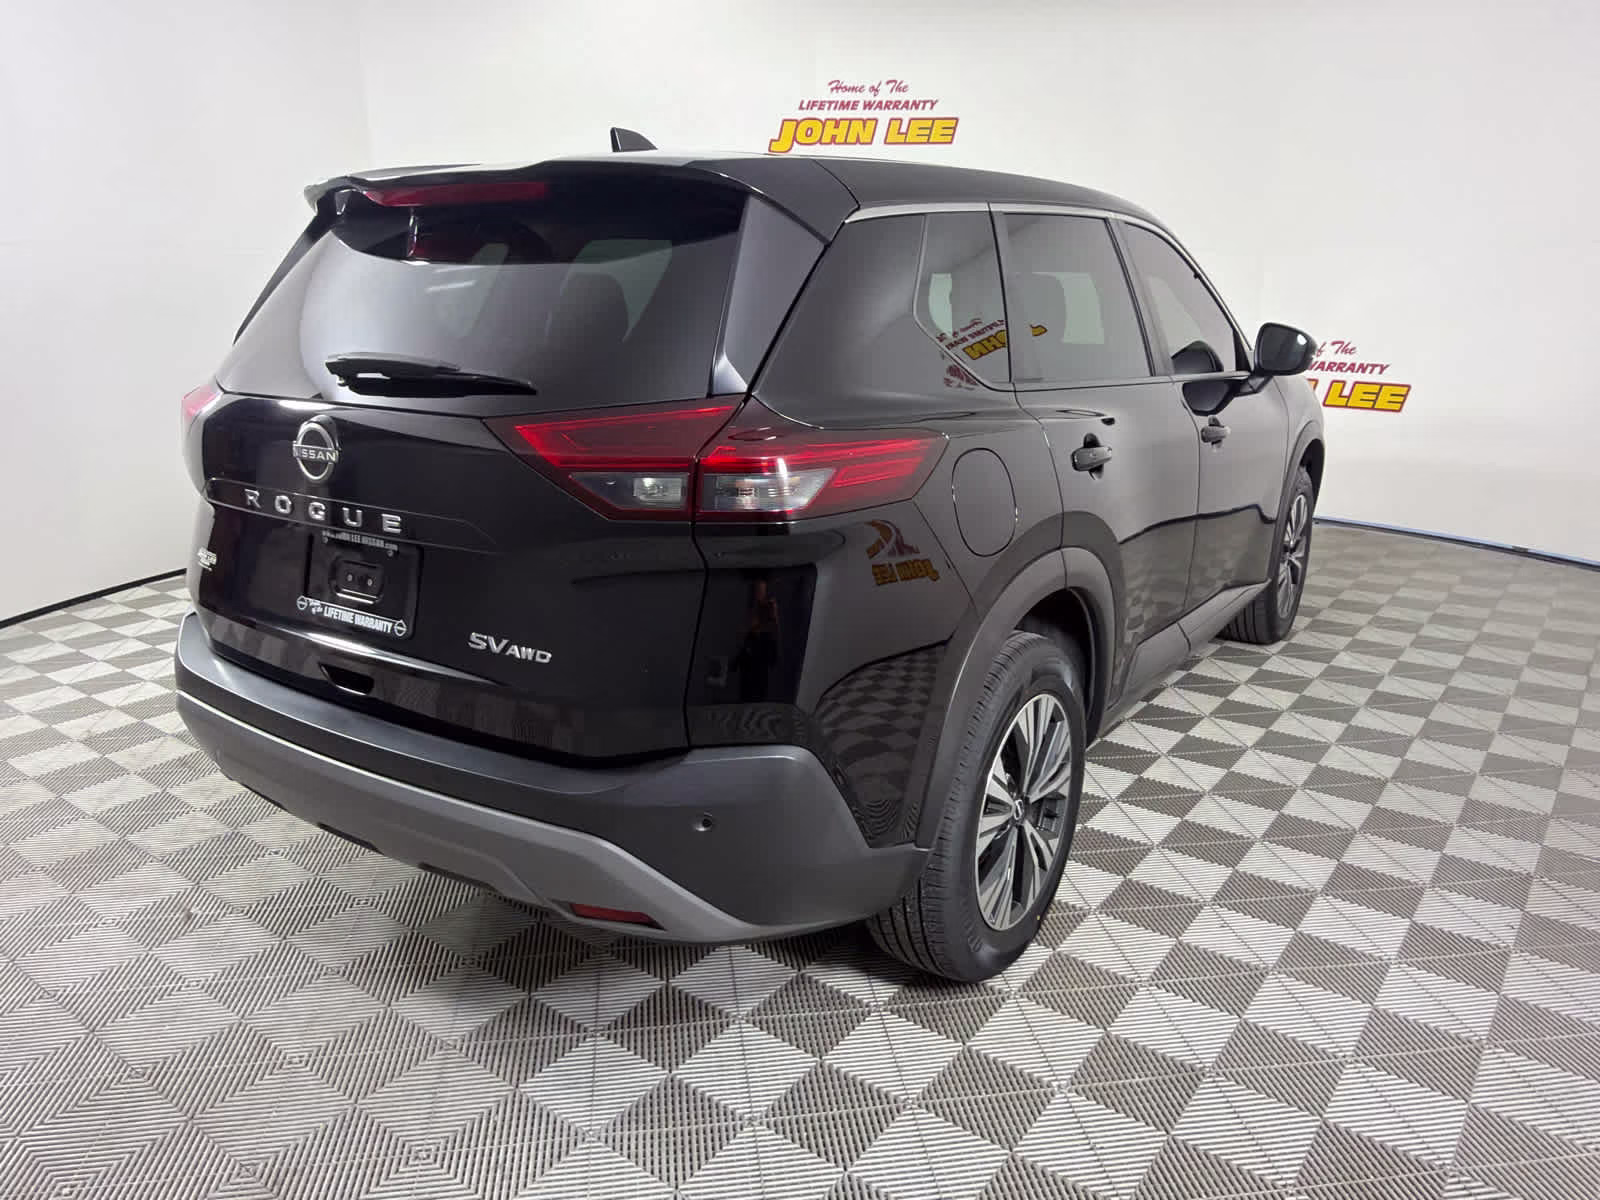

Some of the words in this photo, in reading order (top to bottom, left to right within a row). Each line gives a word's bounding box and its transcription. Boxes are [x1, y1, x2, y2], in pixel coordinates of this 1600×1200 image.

[828, 80, 865, 93] Home
[869, 81, 882, 96] of
[886, 80, 909, 93] The
[798, 100, 859, 111] LIFETIME
[862, 100, 938, 111] WARRANTY
[768, 117, 878, 153] JOHN
[884, 117, 959, 145] LEE
[1316, 342, 1326, 357] f
[1331, 341, 1357, 355] The
[1322, 380, 1411, 412] LEE
[293, 445, 339, 463] NISSAN
[244, 488, 402, 533] ROGUE
[324, 606, 354, 624] LIFETIME
[355, 614, 393, 633] WARRANTY
[468, 632, 509, 654] SV
[505, 645, 552, 663] AWD
